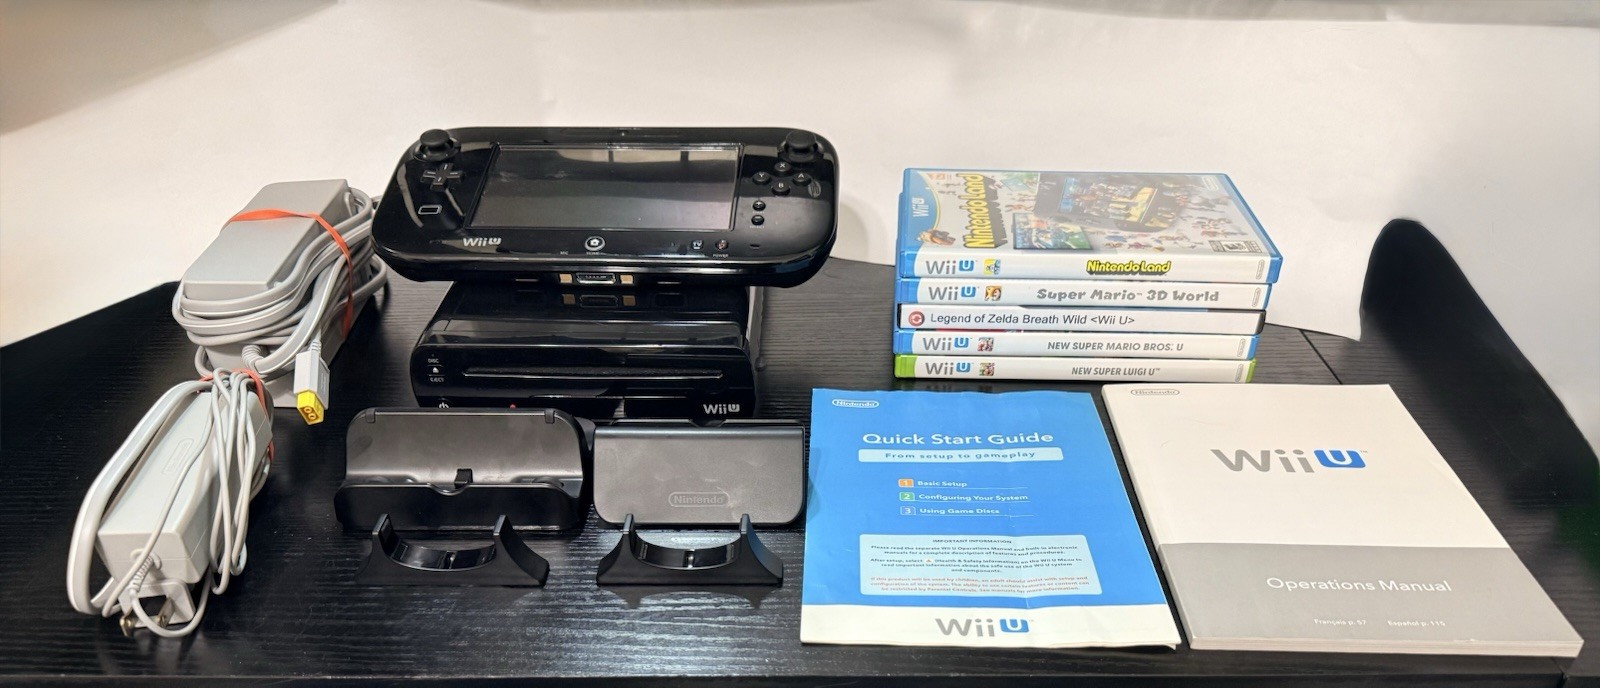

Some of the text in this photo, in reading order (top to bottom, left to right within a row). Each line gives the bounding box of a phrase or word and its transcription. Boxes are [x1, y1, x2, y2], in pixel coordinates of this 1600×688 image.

[463, 238, 487, 247] Wii
[926, 260, 975, 275] Wii U
[928, 286, 976, 301] Wii U
[1037, 289, 1086, 304] Super
[1146, 290, 1169, 301] 3D
[1173, 290, 1220, 302] World
[931, 314, 1136, 325] Legend of Zelda Breath Wild <Wii U>
[923, 337, 969, 351] Wii U
[1047, 342, 1070, 350] NEW
[1072, 342, 1104, 351] SUPER
[1106, 342, 1141, 351] MARIO
[1176, 343, 1184, 351] U
[925, 362, 971, 375] Wii U
[1071, 367, 1092, 375] NEW
[1093, 367, 1122, 376] SUPER
[1123, 368, 1147, 376] LUIGI
[703, 404, 740, 414] Wii U
[862, 432, 1055, 445] Quick Start Guide
[920, 453, 953, 461] setup
[975, 451, 1036, 460] gameplay
[1209, 449, 1366, 472] Wii U
[918, 494, 971, 502] Configuring
[1266, 577, 1452, 591] Operations Manual
[935, 618, 1030, 637] Wii U
[1313, 618, 1347, 626] Français
